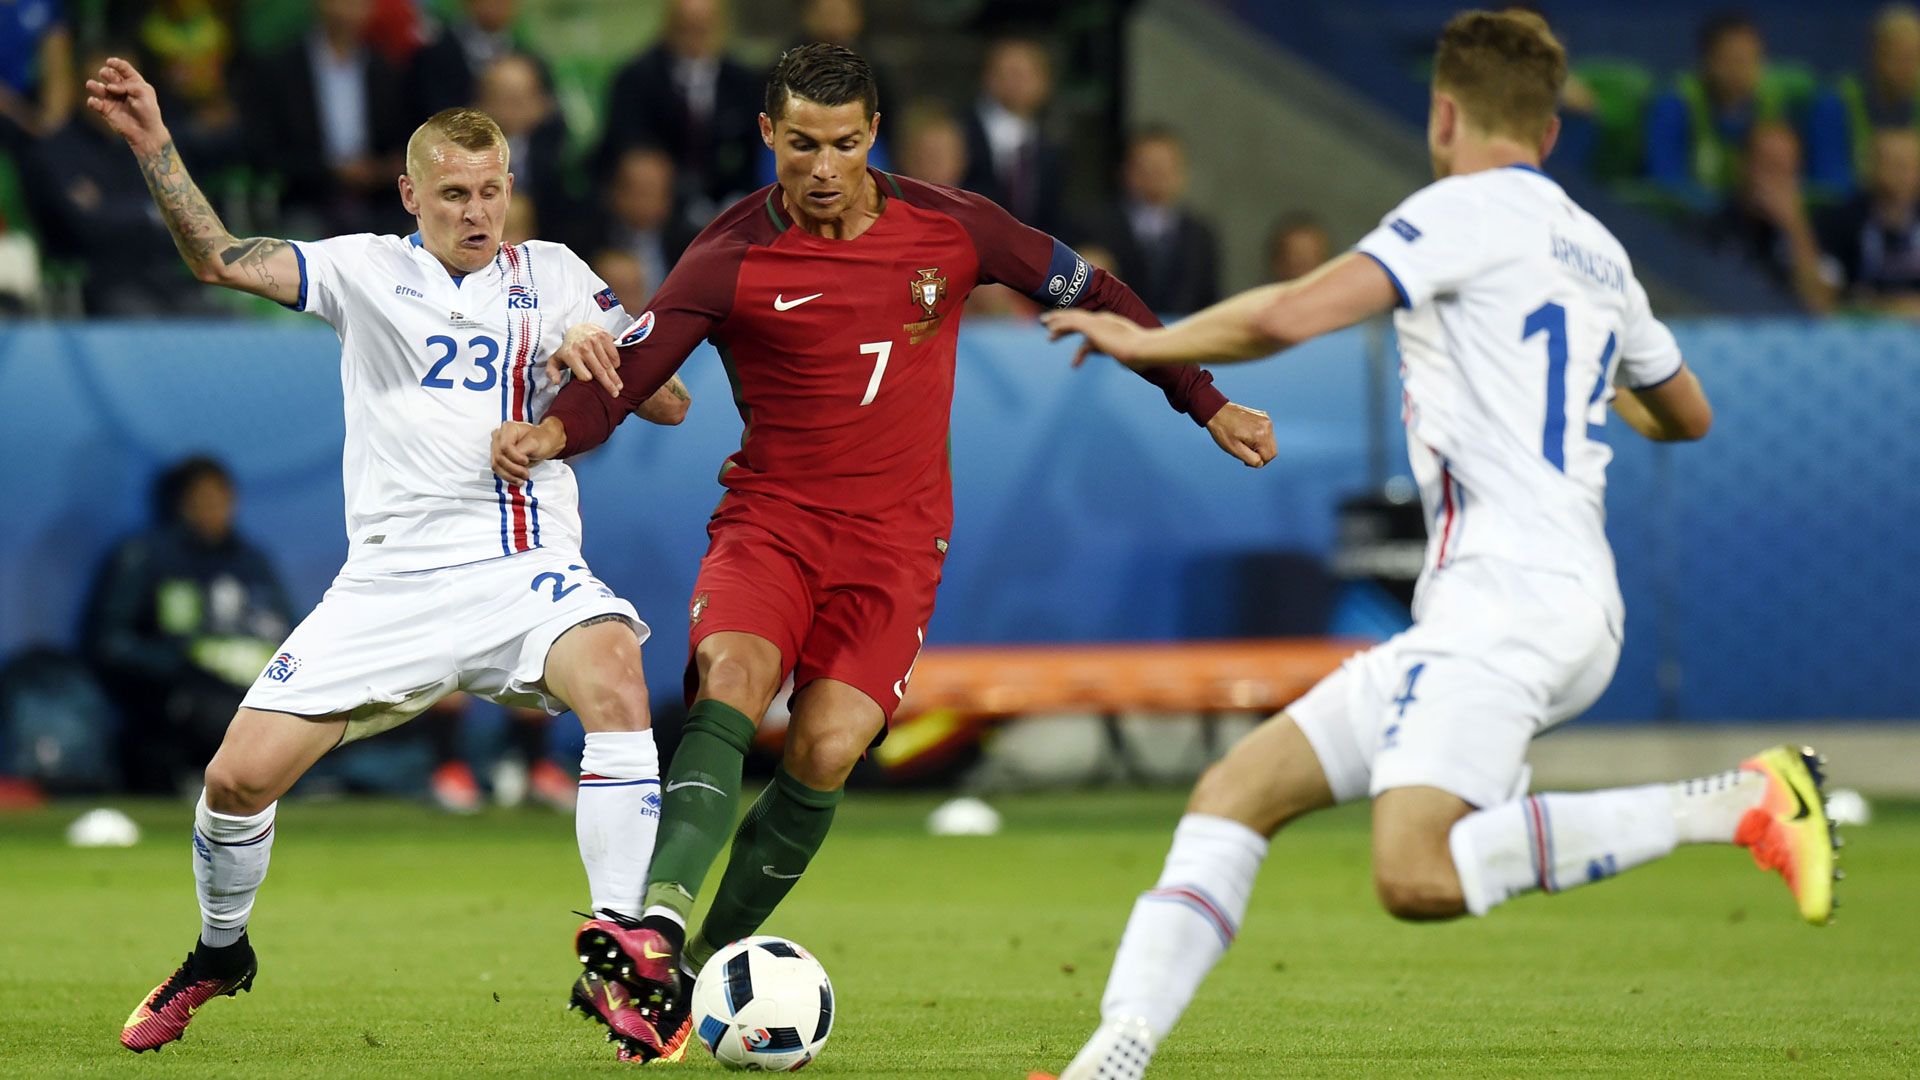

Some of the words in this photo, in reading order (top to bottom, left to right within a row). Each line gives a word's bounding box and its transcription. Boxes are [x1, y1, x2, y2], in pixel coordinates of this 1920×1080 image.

[1069, 260, 1086, 294] RACISM
[420, 334, 500, 392] 23
[859, 340, 893, 406] 7
